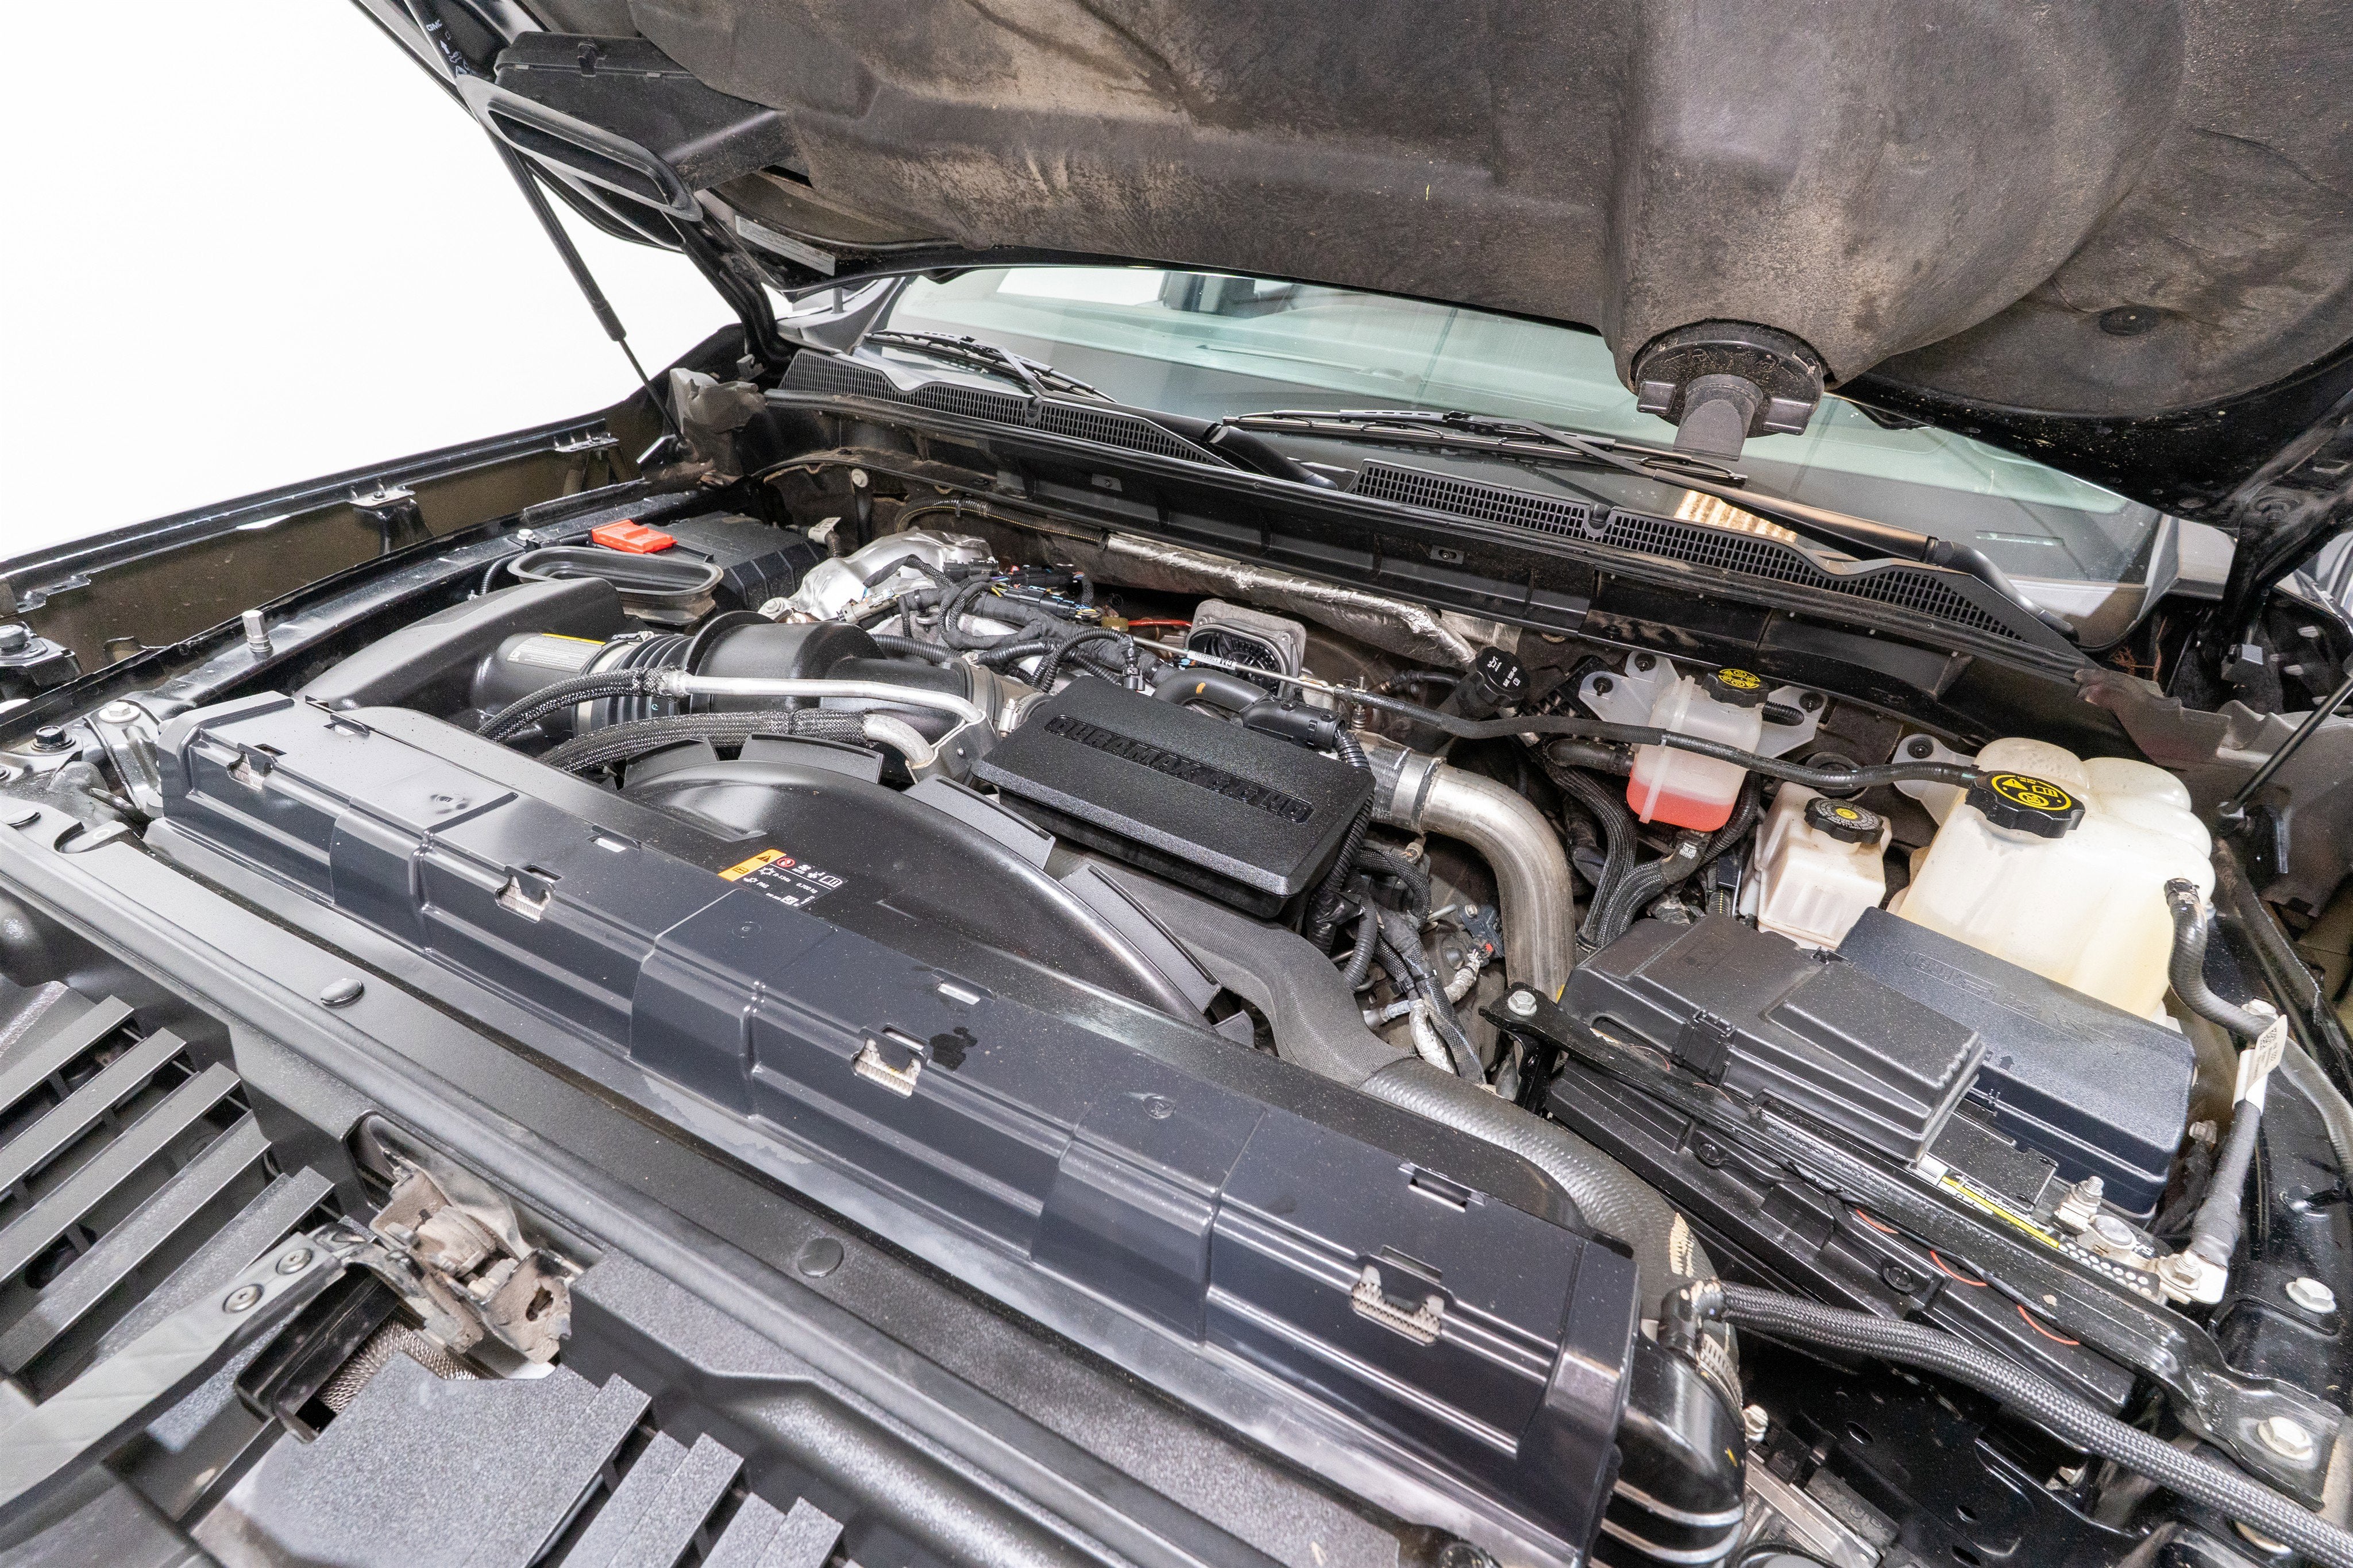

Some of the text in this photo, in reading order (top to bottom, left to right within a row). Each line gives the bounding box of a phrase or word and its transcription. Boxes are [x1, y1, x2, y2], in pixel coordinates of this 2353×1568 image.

[426, 19, 443, 32] GMC
[1220, 658, 1233, 667] GM
[1502, 678, 1510, 688] SAE
[1047, 717, 1309, 820] DURAMAX 6.6 HD
[772, 872, 791, 882] R-134a
[796, 882, 812, 891] 0.700
